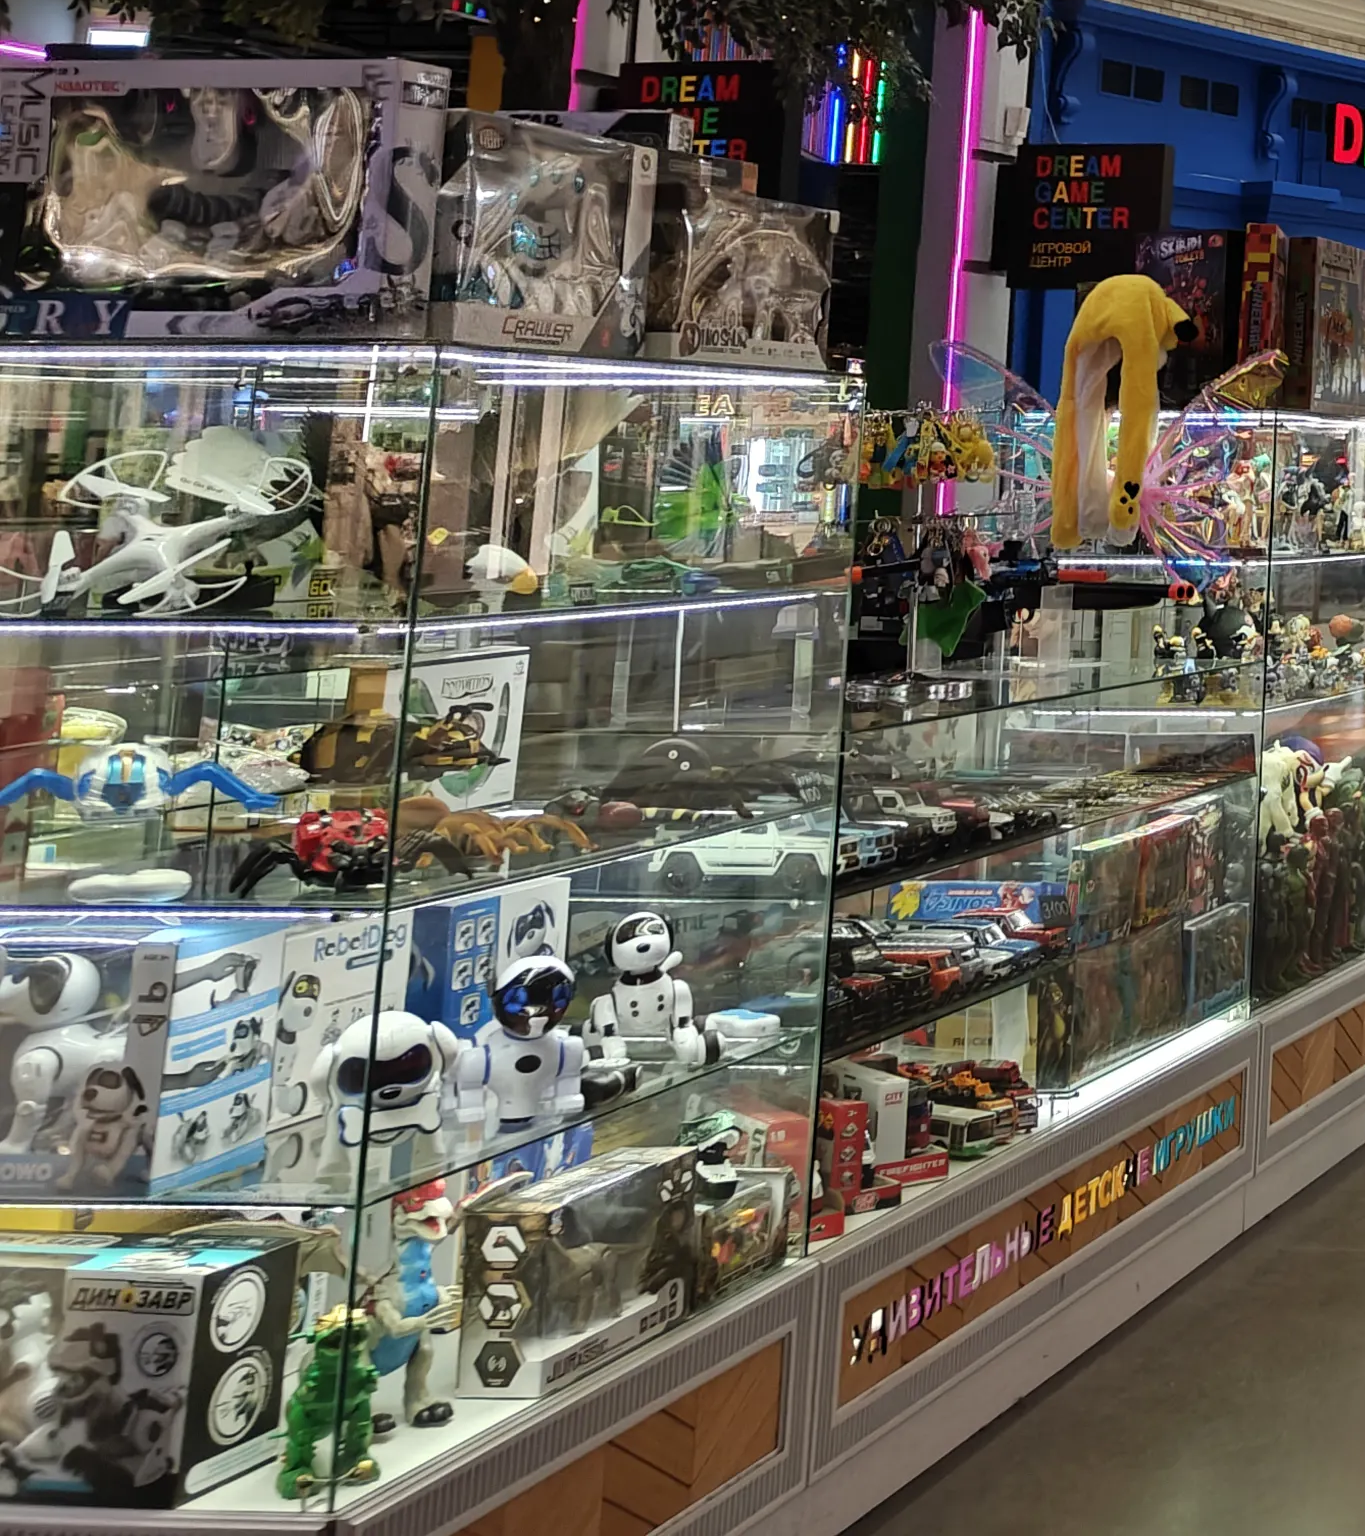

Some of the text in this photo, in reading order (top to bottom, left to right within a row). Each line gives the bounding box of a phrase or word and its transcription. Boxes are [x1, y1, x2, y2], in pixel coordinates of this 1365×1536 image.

[641, 74, 741, 102] DREAM
[1036, 154, 1122, 178] DREAM
[1035, 181, 1105, 204] GAME
[1032, 207, 1130, 230] CENTER
[1032, 241, 1091, 254] ИГРОВОЙ
[1029, 256, 1072, 269] ЦЕНТР
[502, 314, 573, 340] CRAWLER
[850, 1095, 1236, 1366] УДИВИТЕЛЬНЫЕ ДЕТСКИЕ ИГРУШКИ
